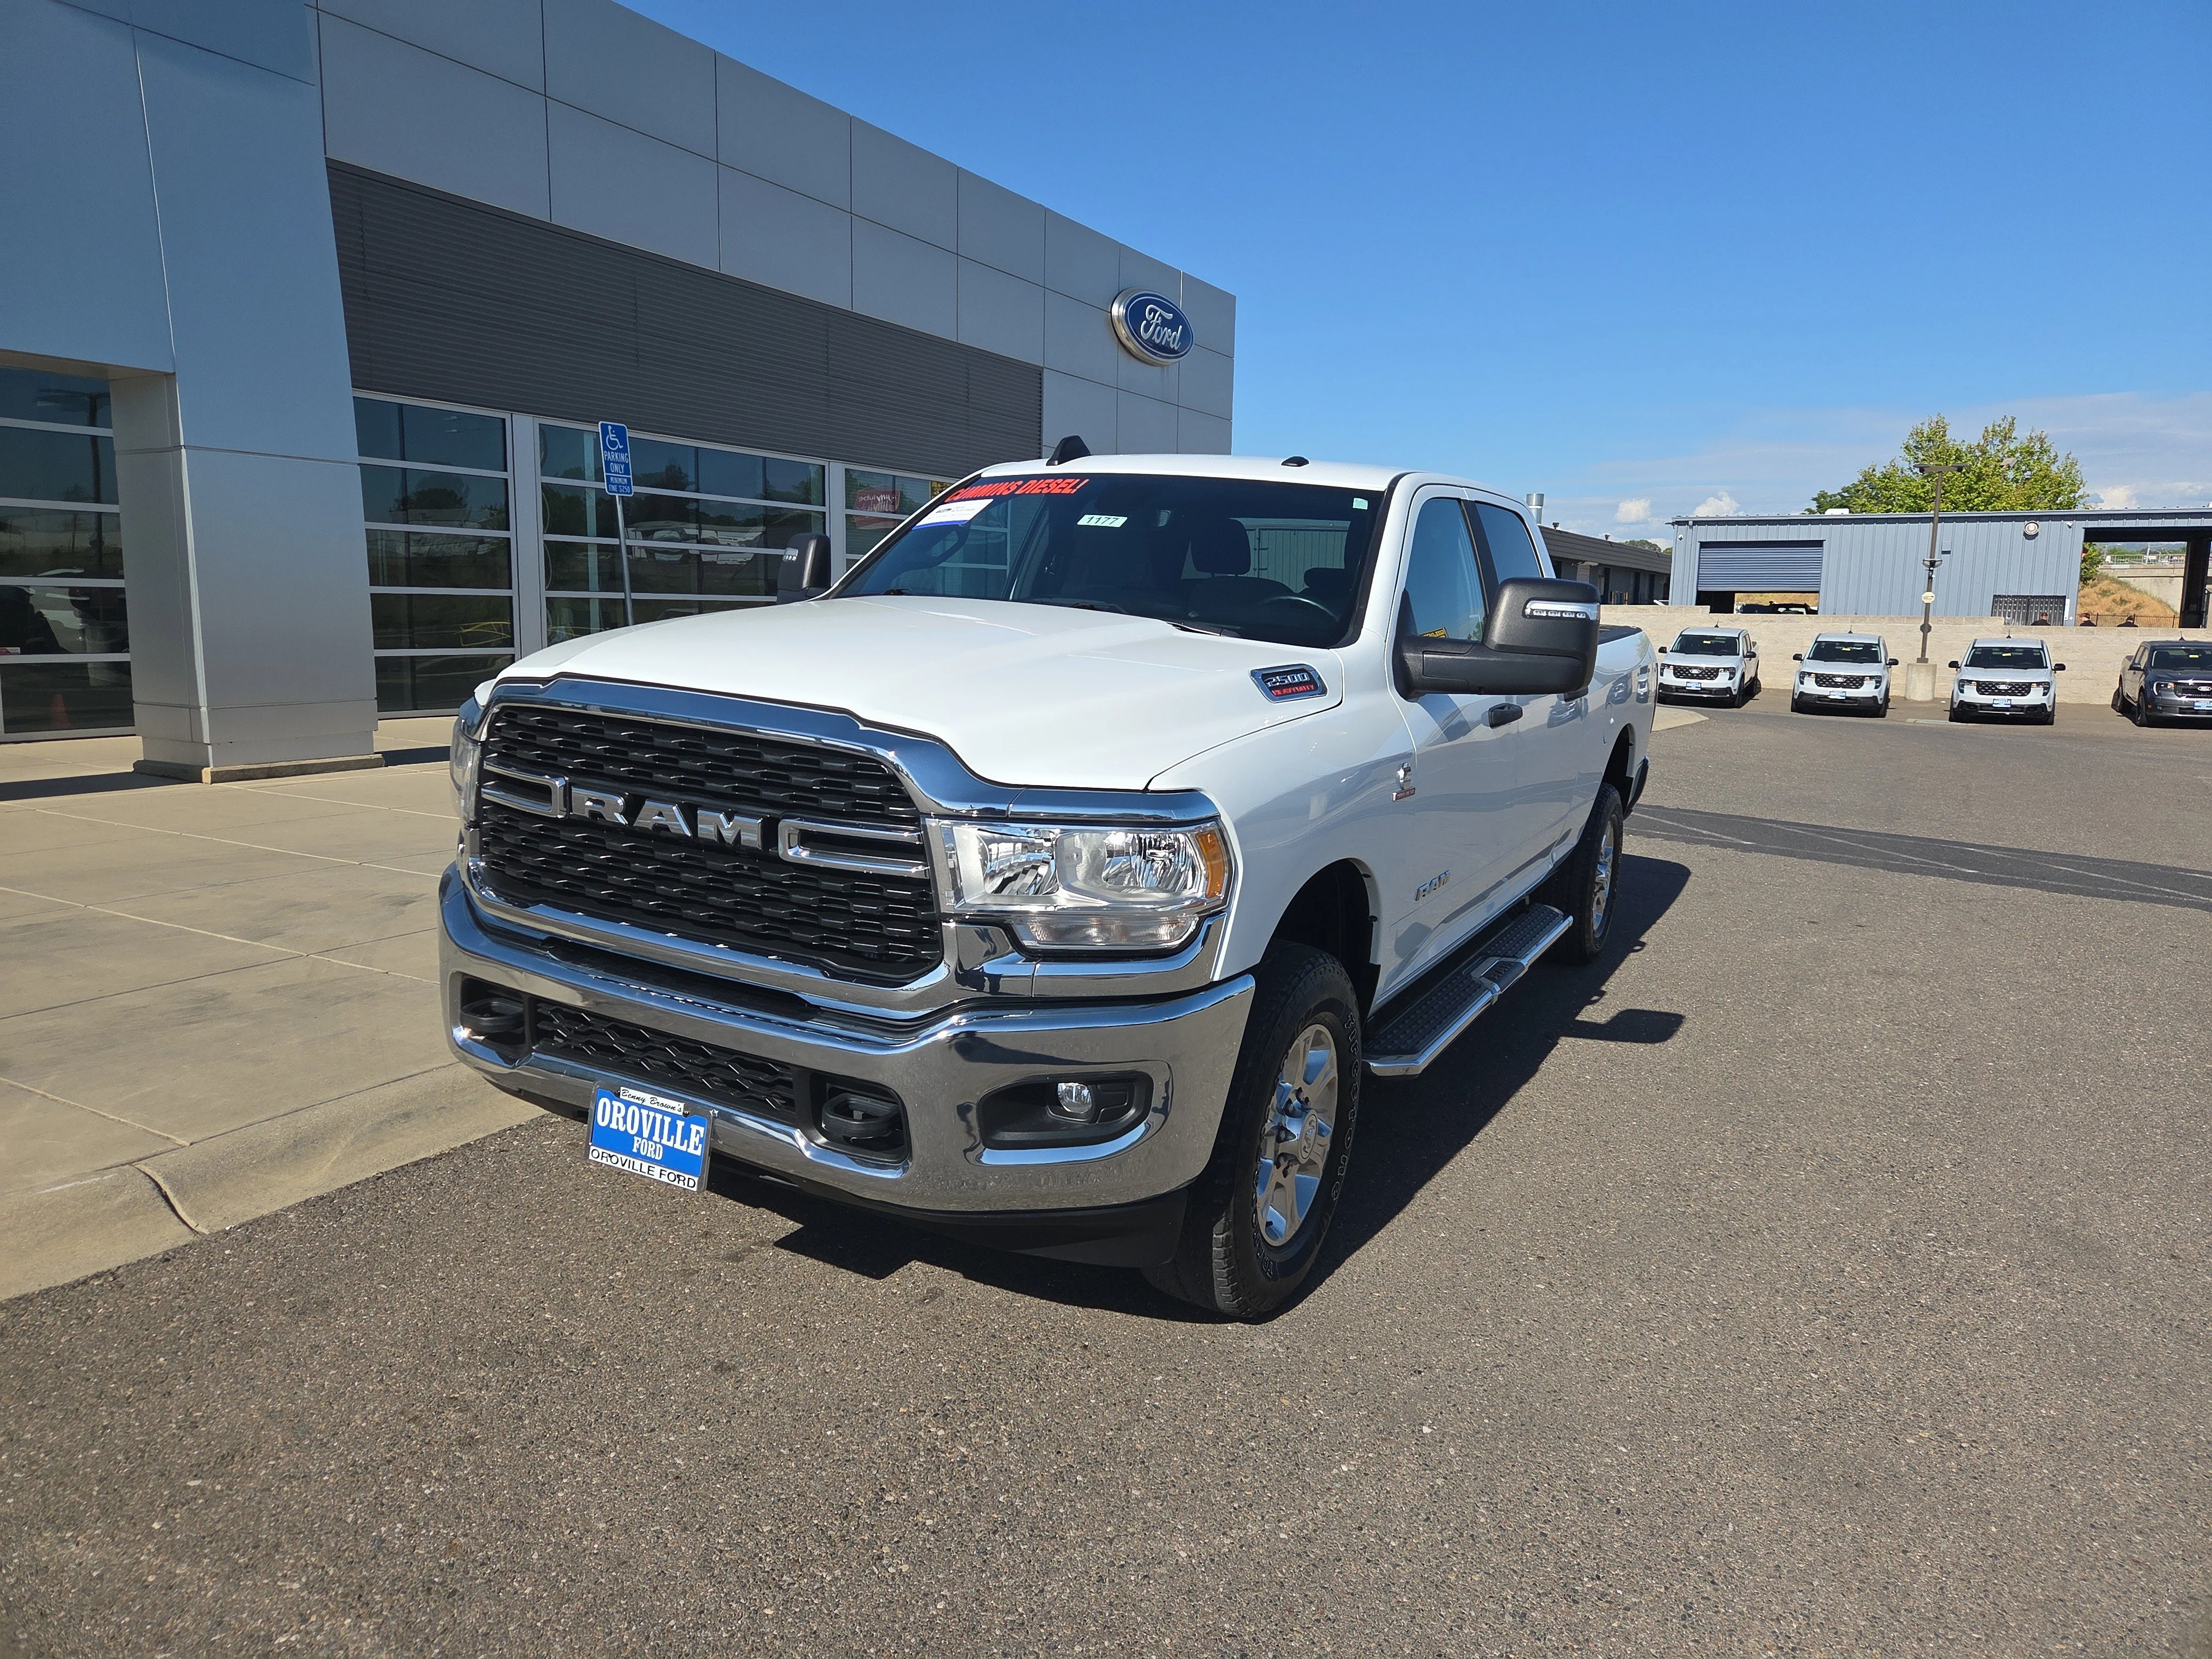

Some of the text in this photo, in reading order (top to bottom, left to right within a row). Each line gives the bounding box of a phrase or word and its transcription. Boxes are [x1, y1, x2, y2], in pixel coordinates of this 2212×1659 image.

[1140, 304, 1182, 351] Ford
[604, 451, 628, 463] PARKING
[610, 462, 624, 473] ONLY
[608, 484, 631, 493] FINE $250
[944, 479, 1090, 503] CUMMINS DIESEL!
[1086, 516, 1120, 525] 1177
[1264, 672, 1310, 687] 2500
[571, 786, 763, 850] RAM
[1414, 869, 1451, 902] RAM
[621, 1089, 683, 1113] Benny Brown's
[597, 1097, 705, 1156] OROVILLE
[632, 1136, 664, 1160] FORD
[591, 1149, 696, 1189] OROVILLE FORD
